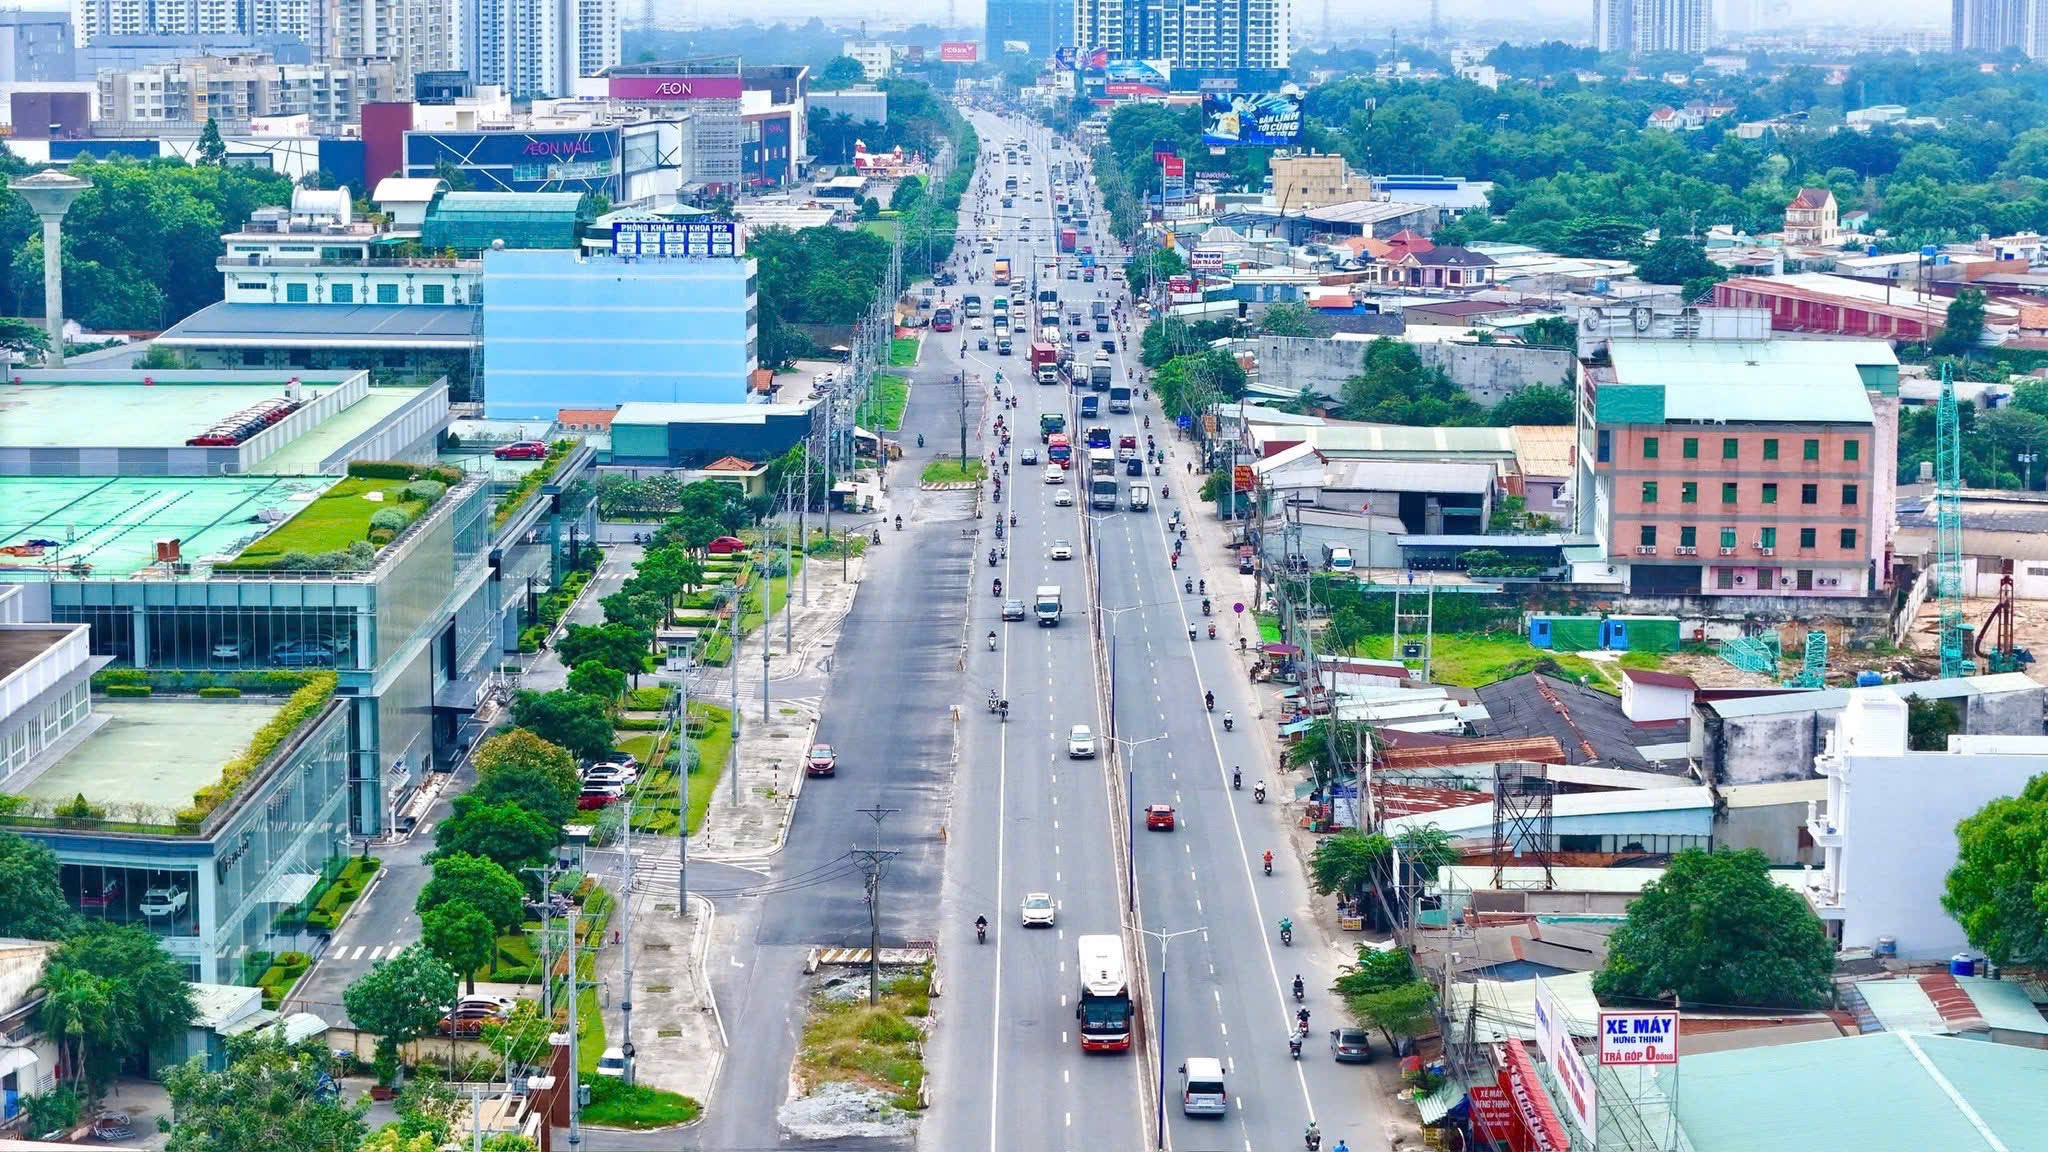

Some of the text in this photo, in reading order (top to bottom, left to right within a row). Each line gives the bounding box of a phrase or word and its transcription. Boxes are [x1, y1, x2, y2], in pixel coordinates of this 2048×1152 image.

[563, 141, 594, 154] MALL
[690, 224, 710, 232] KHOA
[713, 224, 727, 232] PF2
[1606, 1016, 1672, 1034] XE MÁY
[1604, 1049, 1621, 1061] TRẢ
[1624, 1050, 1643, 1061] GÓP
[1645, 1045, 1656, 1061] 0
